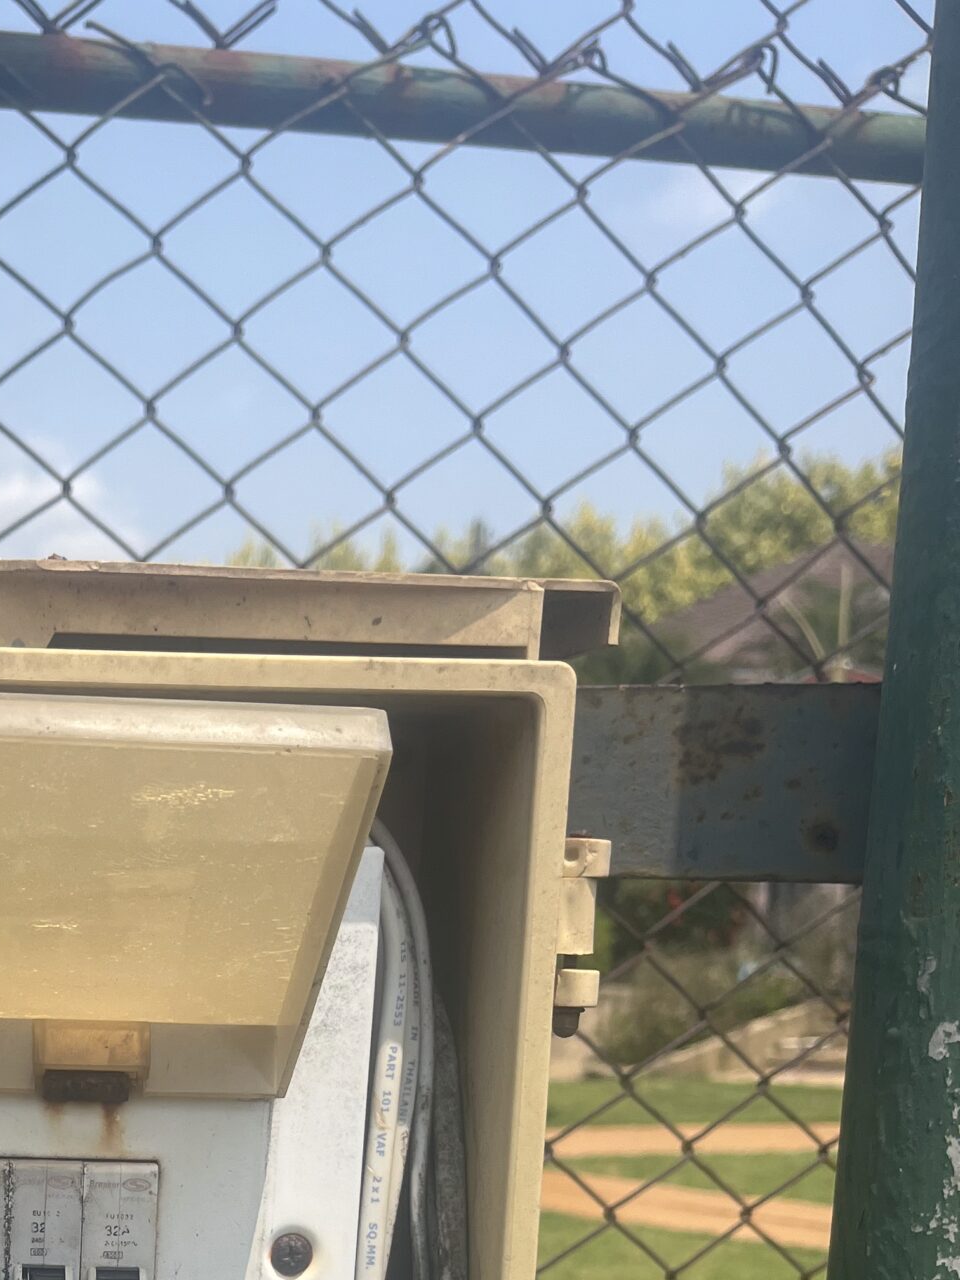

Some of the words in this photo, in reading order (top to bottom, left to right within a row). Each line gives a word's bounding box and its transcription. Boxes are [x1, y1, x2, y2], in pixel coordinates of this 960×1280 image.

[394, 973, 406, 1026] 11-2553
[410, 1026, 418, 1041] IN
[385, 1046, 398, 1080] PART
[381, 1091, 391, 1112] 101
[376, 1132, 387, 1157] VAF
[365, 1223, 378, 1270] SQ.MM.
